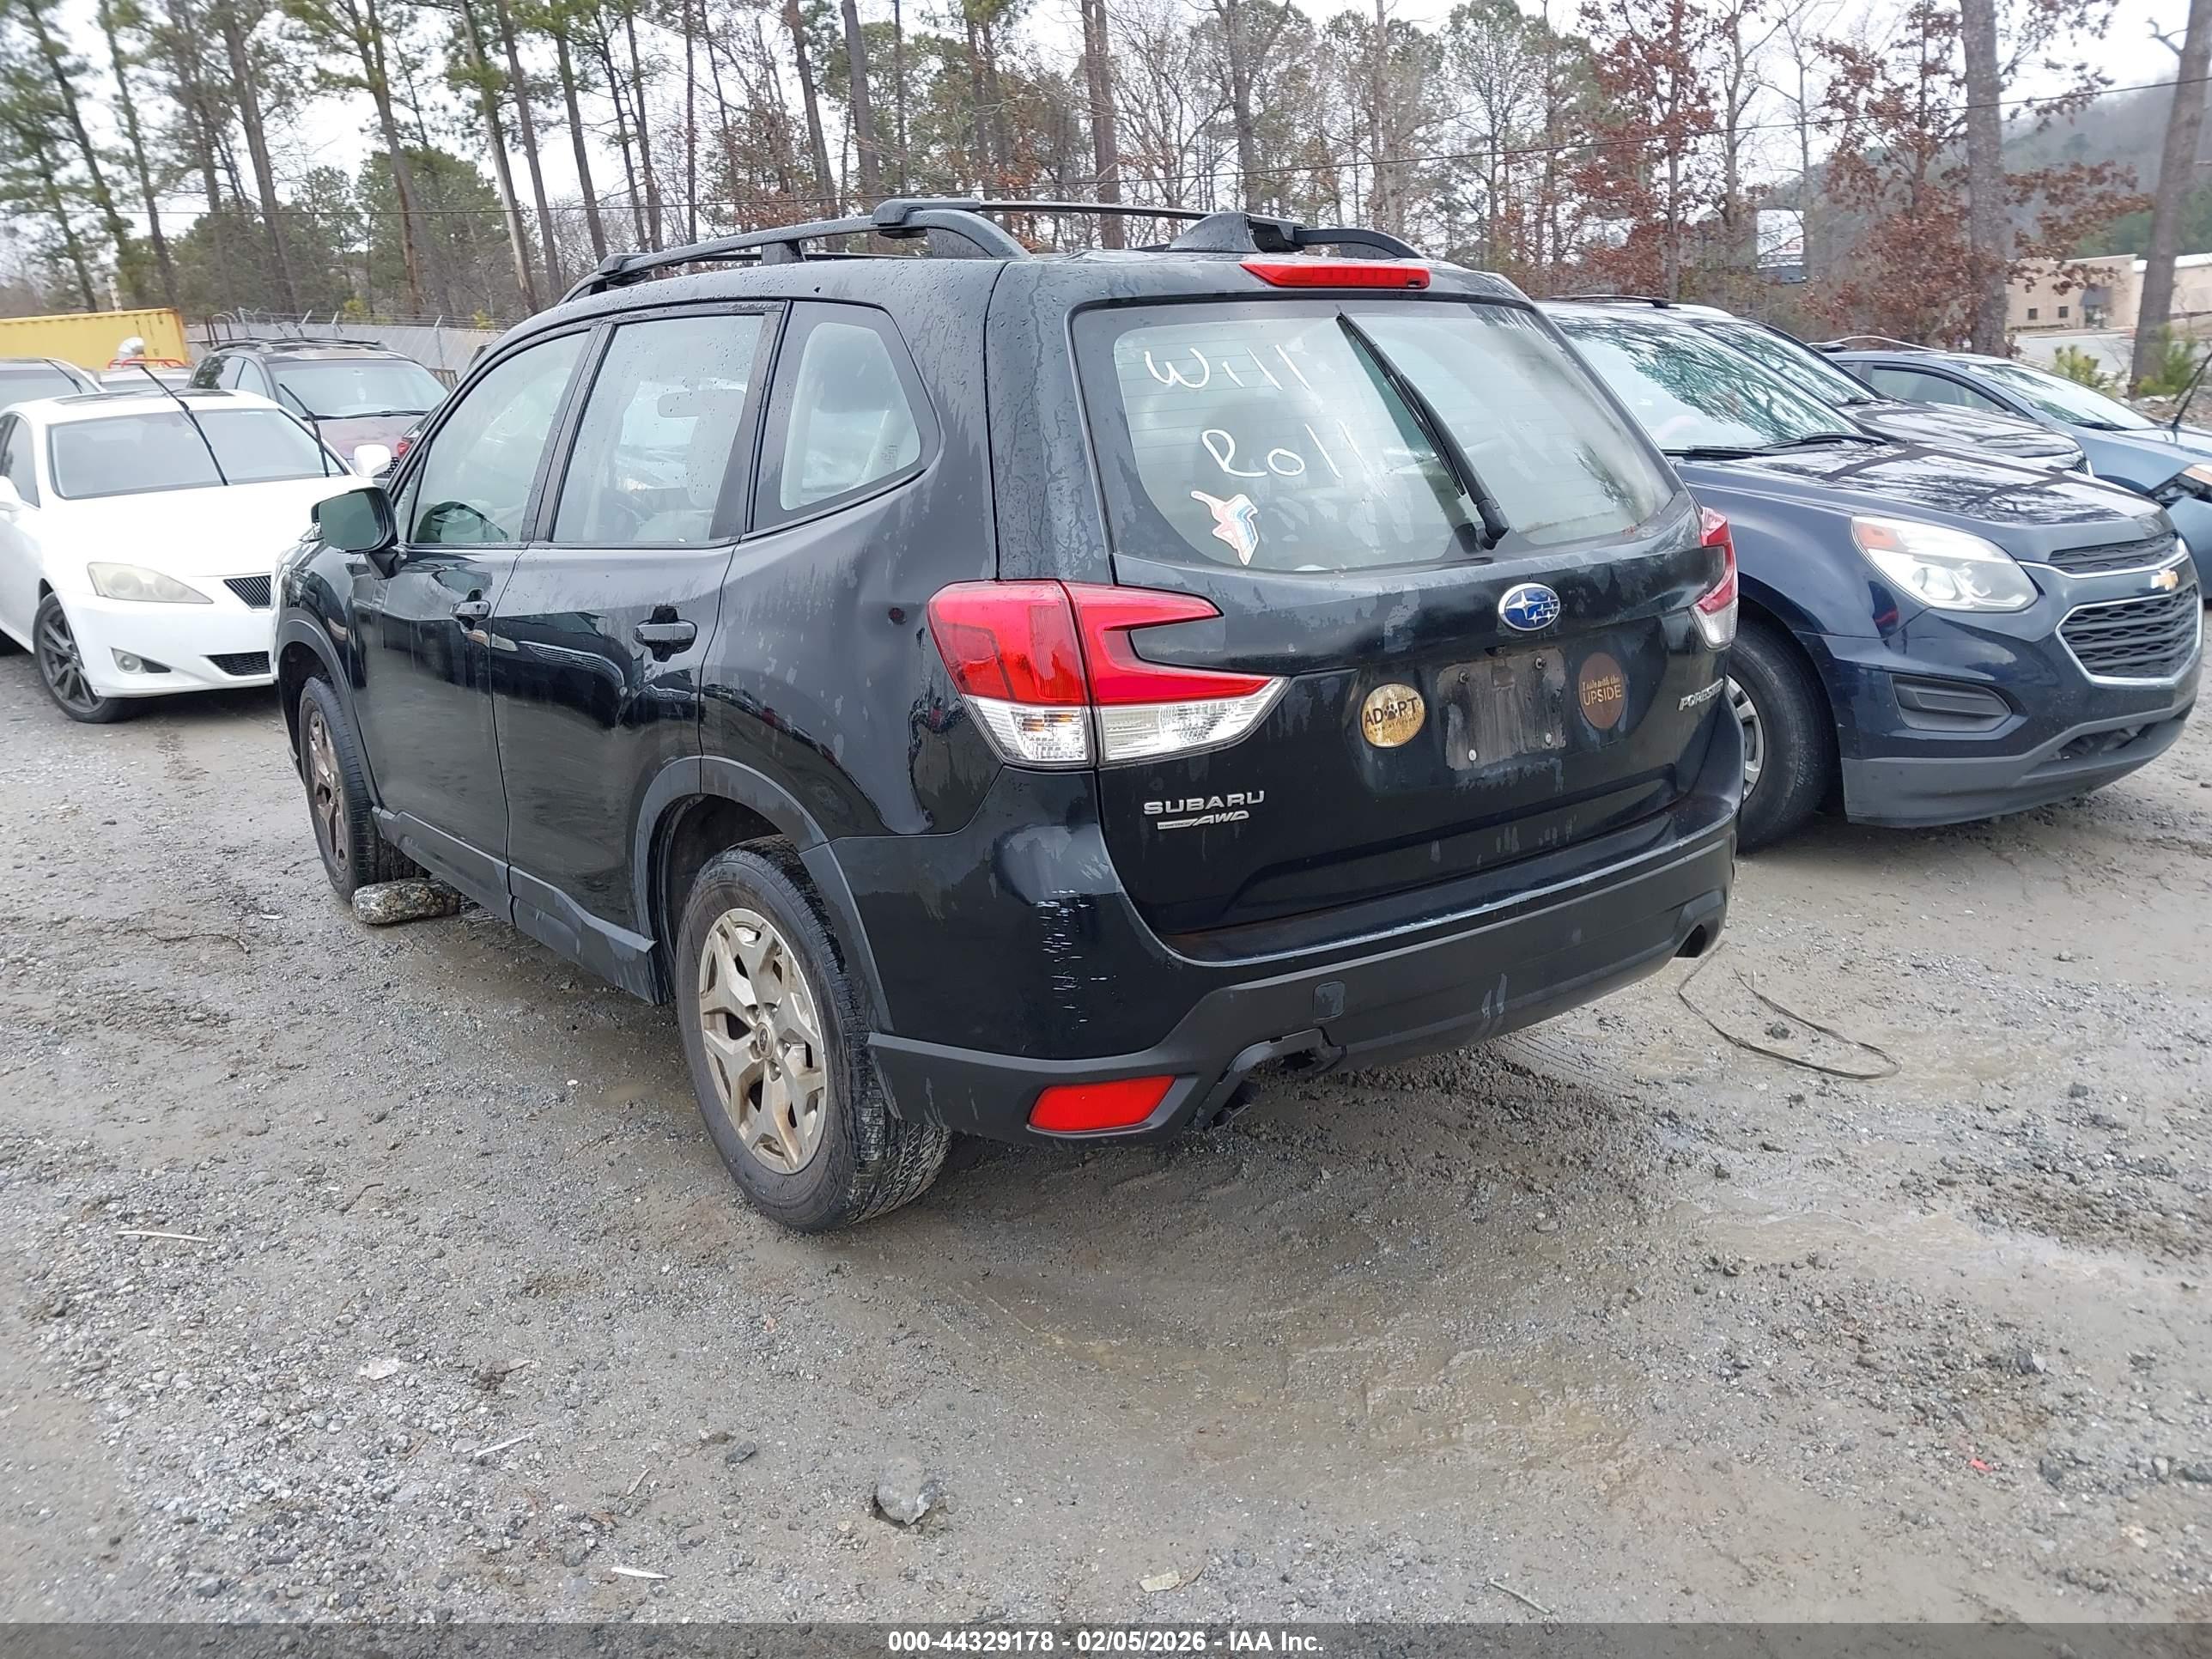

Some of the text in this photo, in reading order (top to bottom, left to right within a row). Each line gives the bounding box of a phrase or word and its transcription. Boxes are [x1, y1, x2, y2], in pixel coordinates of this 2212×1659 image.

[1144, 343, 1311, 392] Will
[1201, 418, 1388, 499] Roll
[1583, 684, 1622, 706] UPSIDE
[1143, 790, 1265, 815] SUBARU
[1193, 810, 1249, 827] AWD
